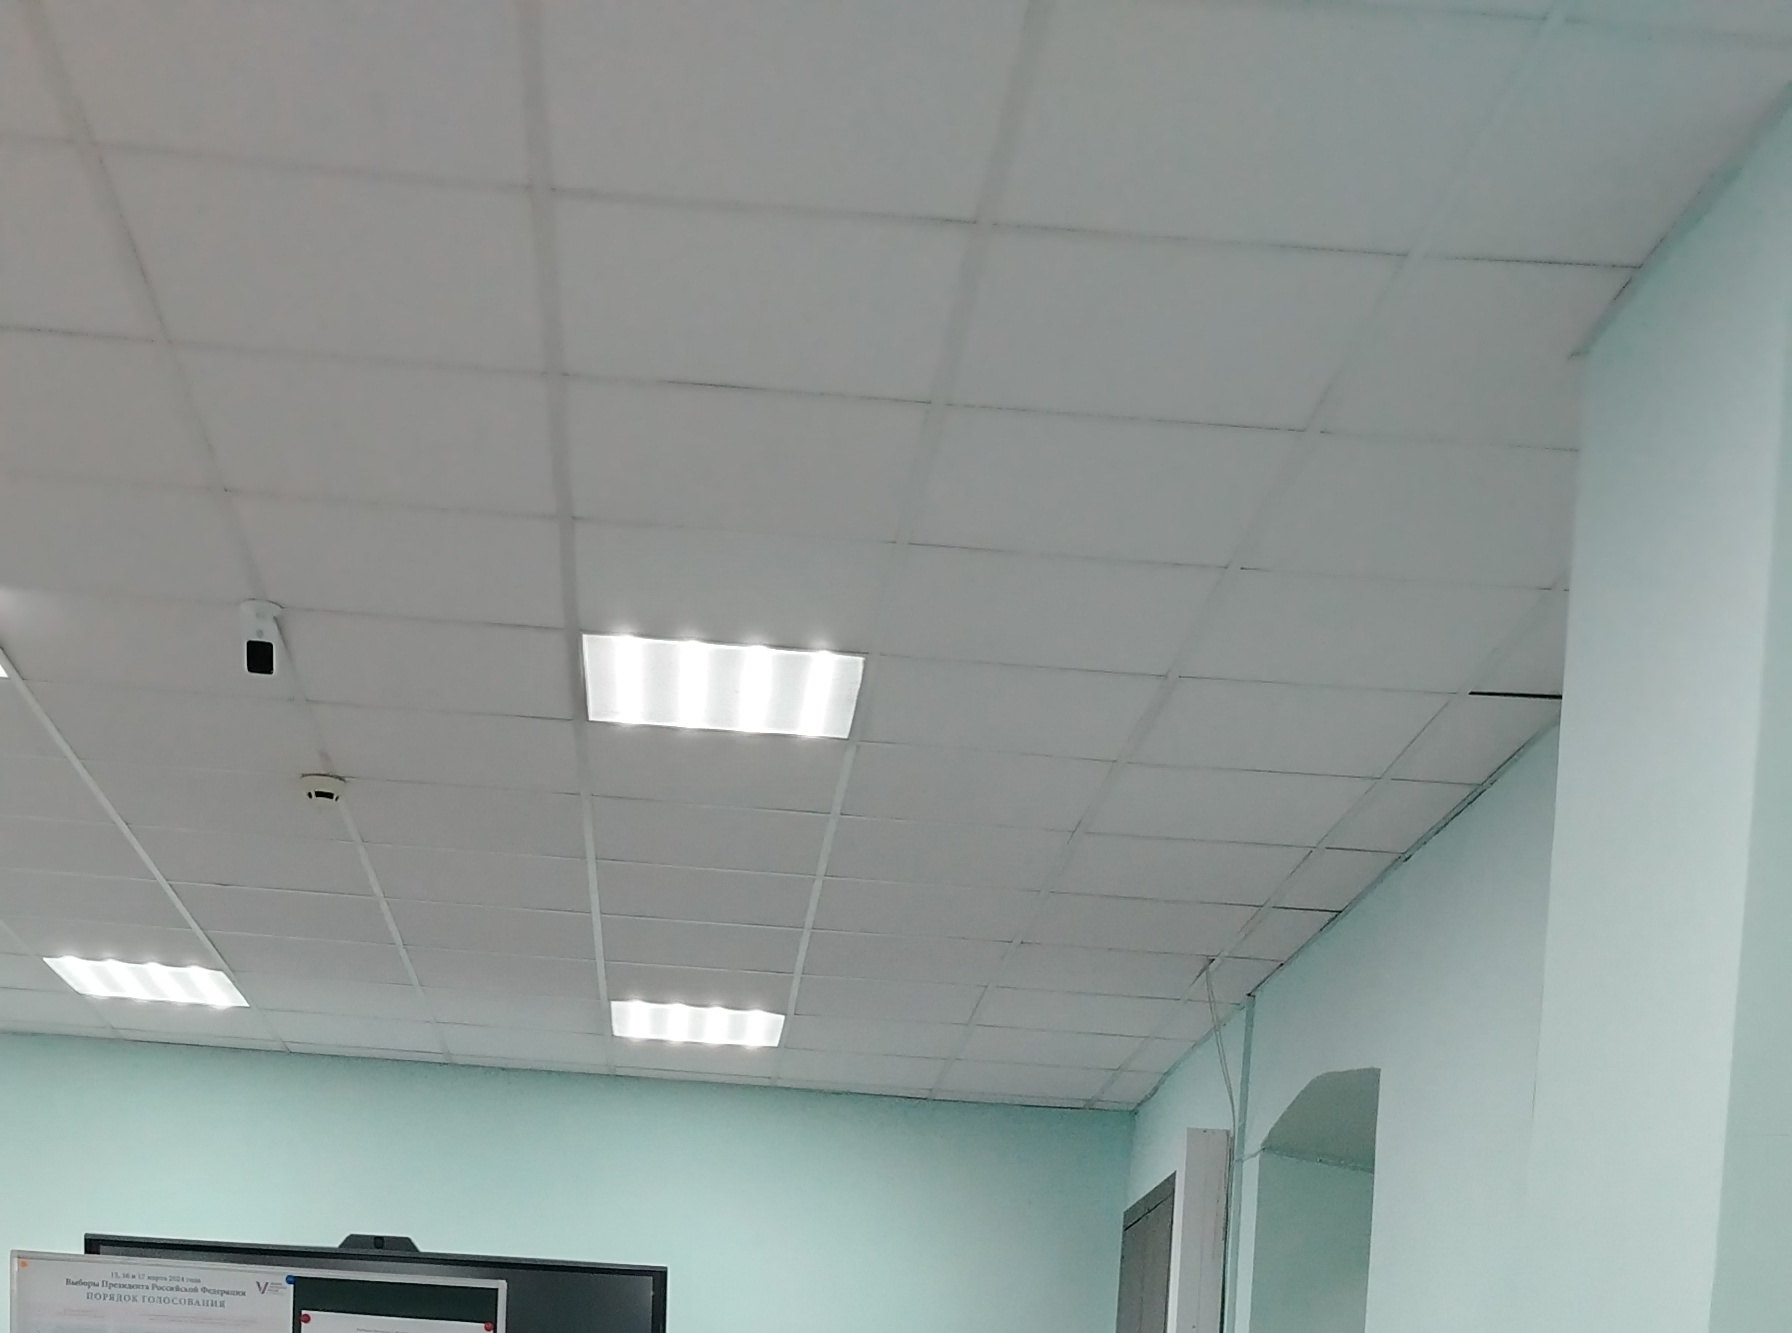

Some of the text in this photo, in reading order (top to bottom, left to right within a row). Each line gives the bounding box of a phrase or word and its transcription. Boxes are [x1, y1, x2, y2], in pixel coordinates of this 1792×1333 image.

[65, 1278, 99, 1289] Выборы
[101, 1280, 149, 1290] Президента
[151, 1283, 198, 1293] Российской
[86, 1291, 226, 1308] ПОРЯДОК ГОЛОСОВАНИЯ
